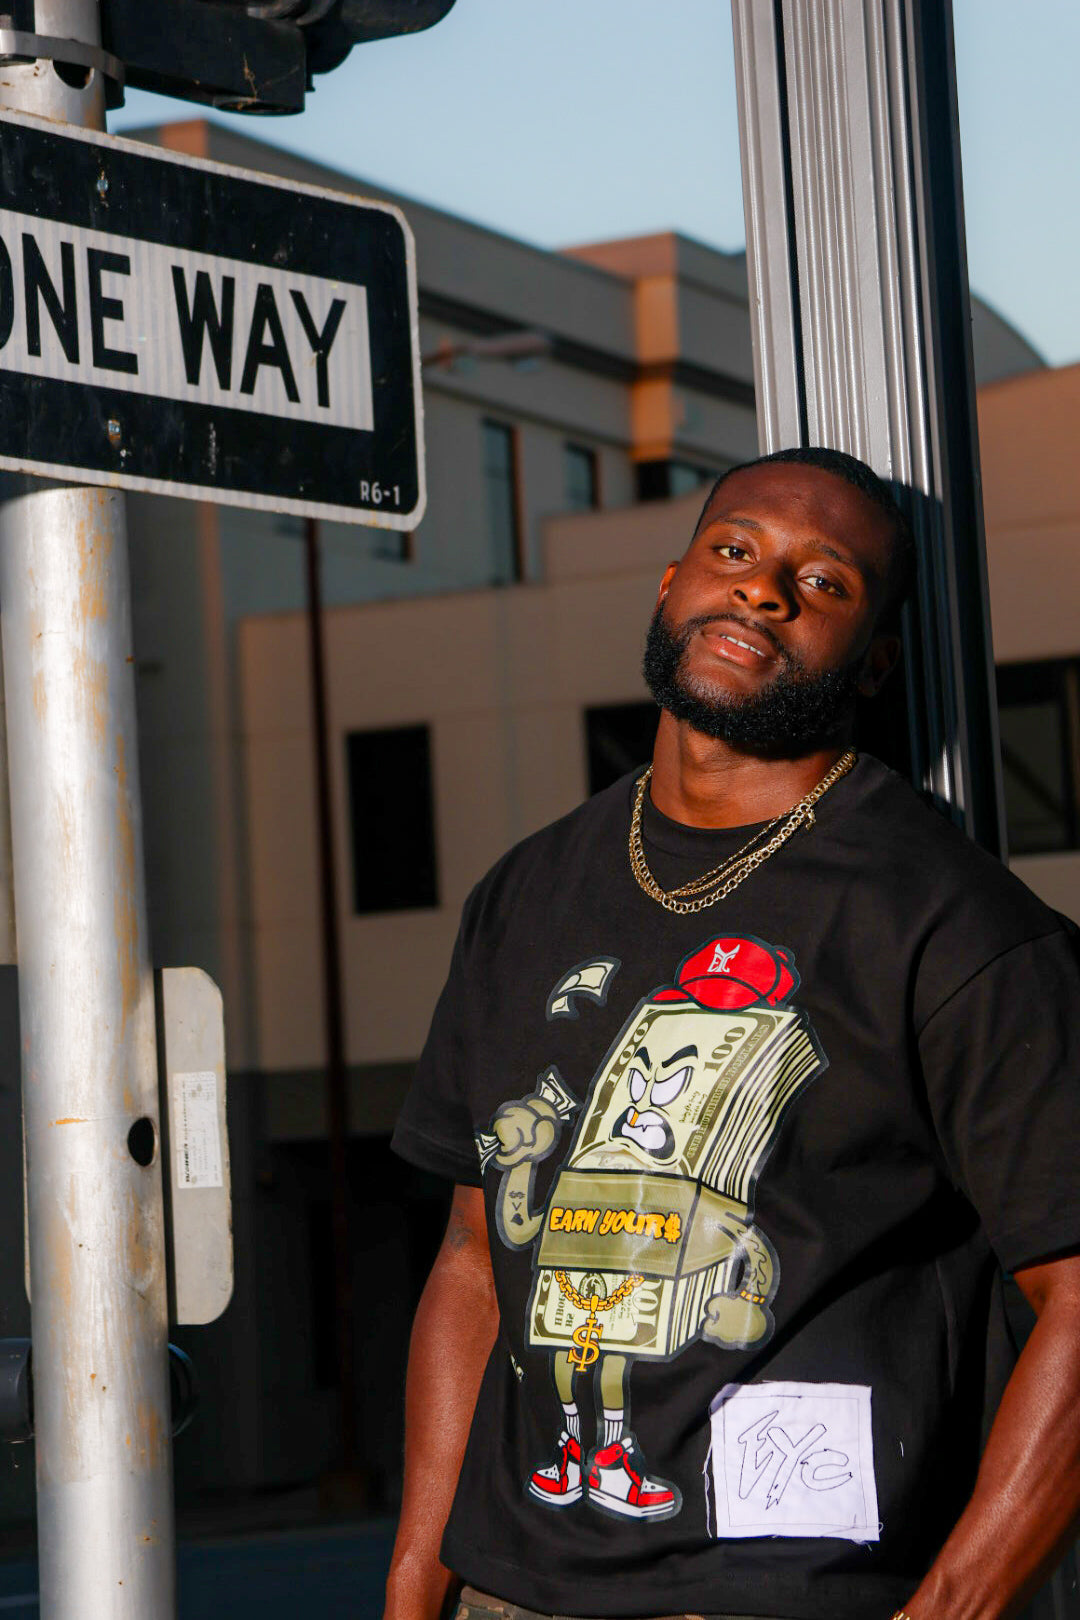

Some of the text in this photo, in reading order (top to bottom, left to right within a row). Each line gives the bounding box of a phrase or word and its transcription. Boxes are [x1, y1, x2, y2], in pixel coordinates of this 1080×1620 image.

[0, 232, 347, 409] NE WAY
[360, 480, 400, 506] R6-1
[606, 1021, 650, 1089] 100
[703, 1026, 747, 1074] 100
[550, 1207, 683, 1244] EARN YOUR$
